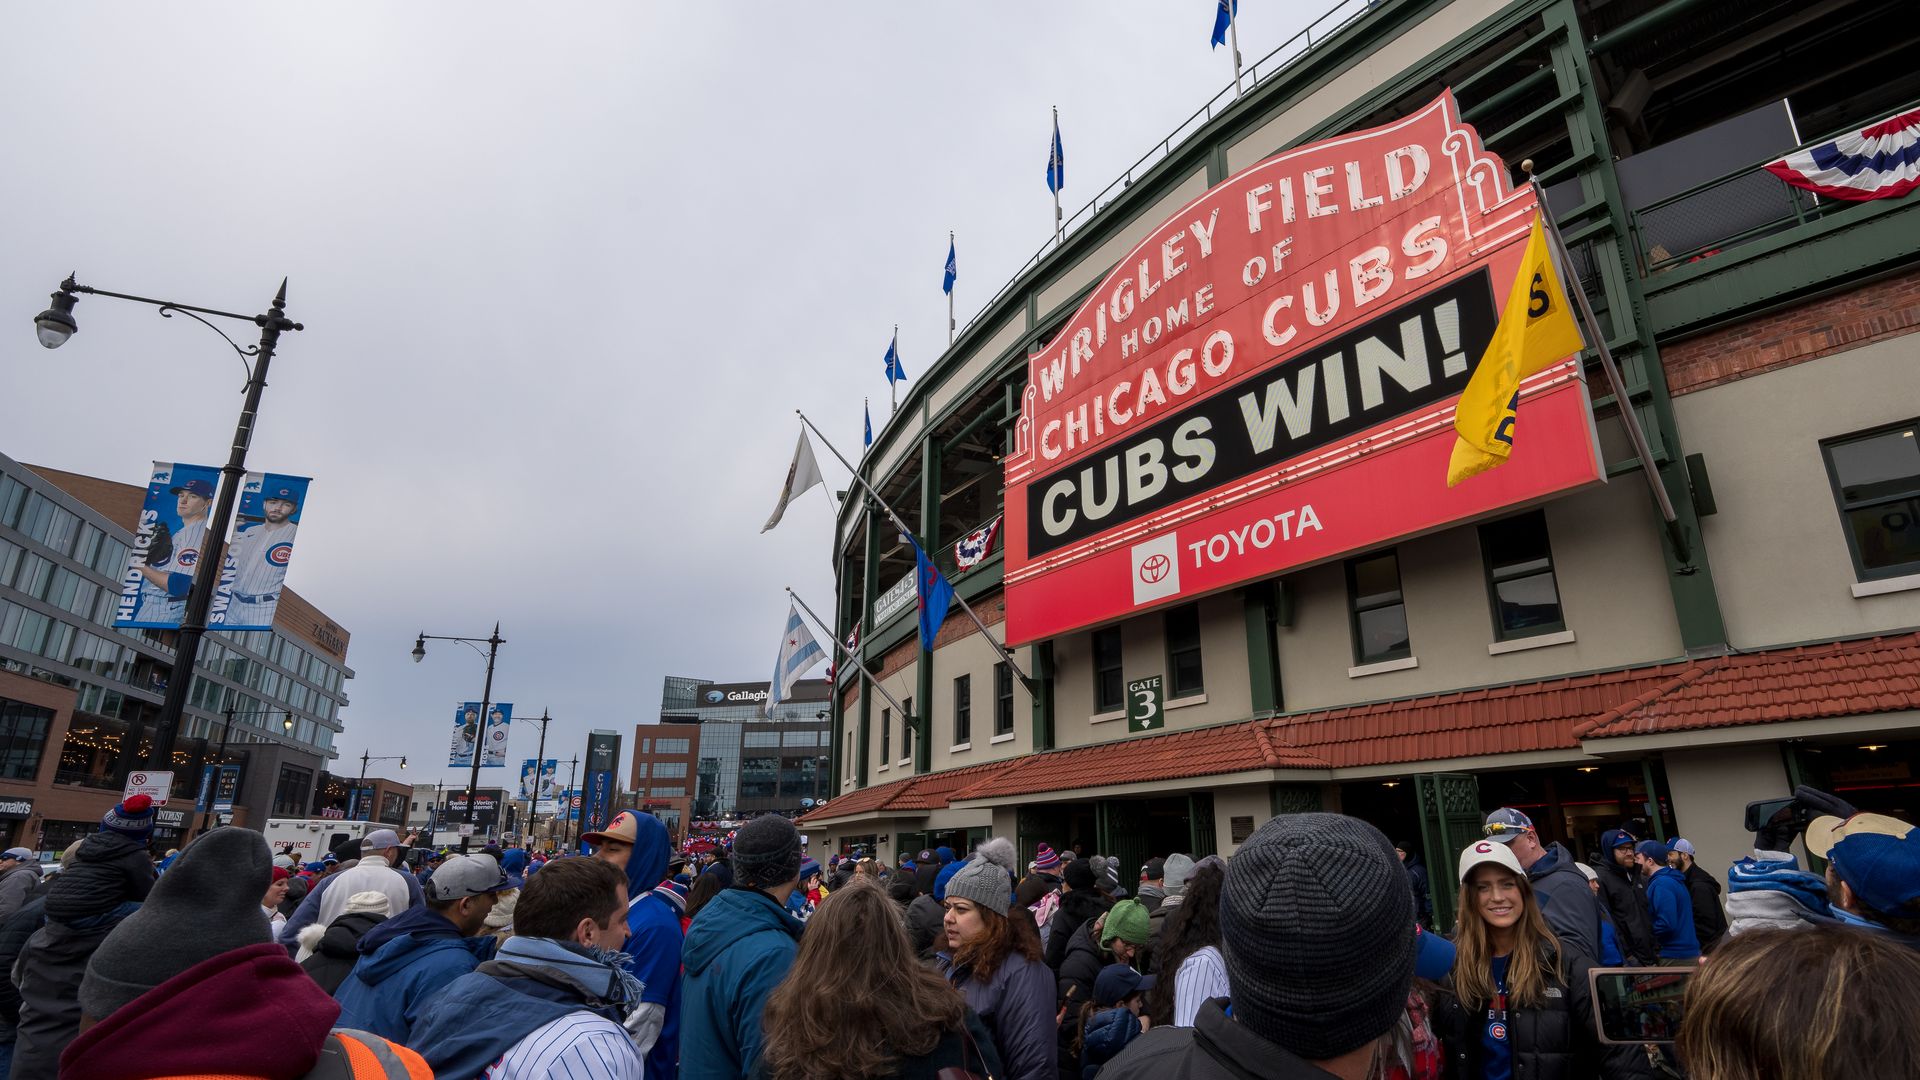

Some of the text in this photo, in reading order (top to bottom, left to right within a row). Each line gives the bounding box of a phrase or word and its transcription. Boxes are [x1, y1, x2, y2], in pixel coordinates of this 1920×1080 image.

[1039, 143, 1431, 403] WRIGLEY FIELD
[1122, 236, 1294, 359] HOME OF
[1040, 215, 1449, 460] CHICAGO CUBS
[1041, 298, 1468, 538] CUBS WIN!
[116, 509, 159, 621] HENDRICKS
[1188, 504, 1323, 568] TOYOTA
[728, 691, 770, 701] Gallagh
[1129, 677, 1160, 692] GATE
[1134, 690, 1157, 720] 3
[1475, 842, 1492, 854] C
